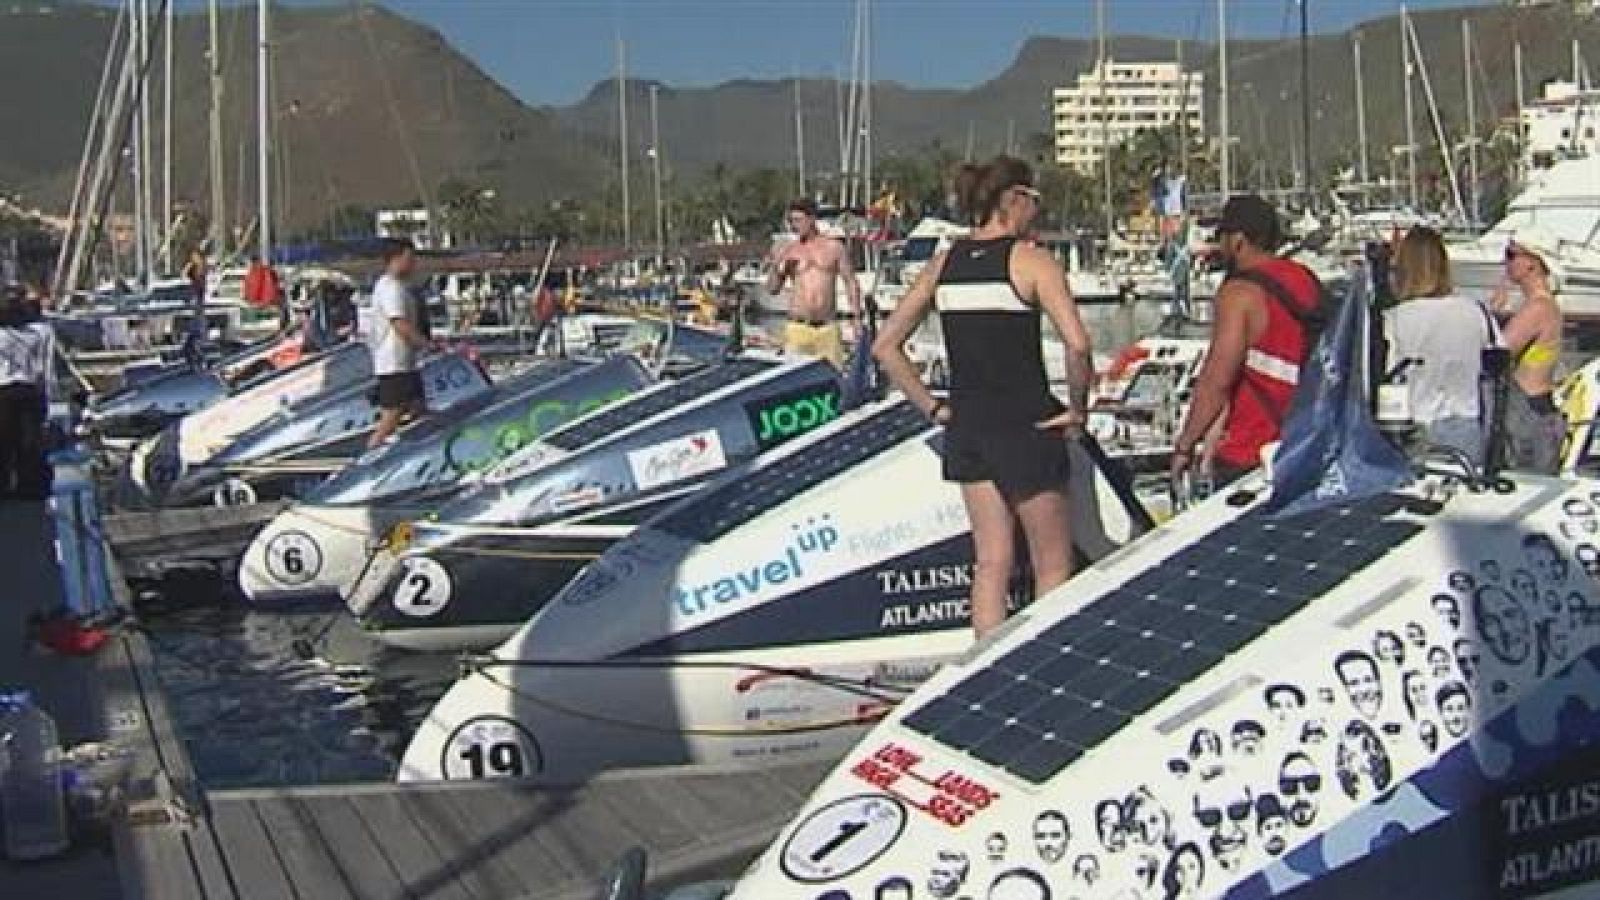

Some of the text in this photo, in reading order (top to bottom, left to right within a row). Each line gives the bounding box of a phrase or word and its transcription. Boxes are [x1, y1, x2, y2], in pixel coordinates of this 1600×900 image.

[283, 547, 303, 575] 6
[677, 547, 803, 616] travel
[797, 526, 839, 552] up
[877, 563, 978, 593] TALISK
[410, 574, 432, 606] 2
[459, 743, 523, 781] 19
[874, 743, 1001, 809] LOW LANDS
[810, 821, 869, 862] 1
